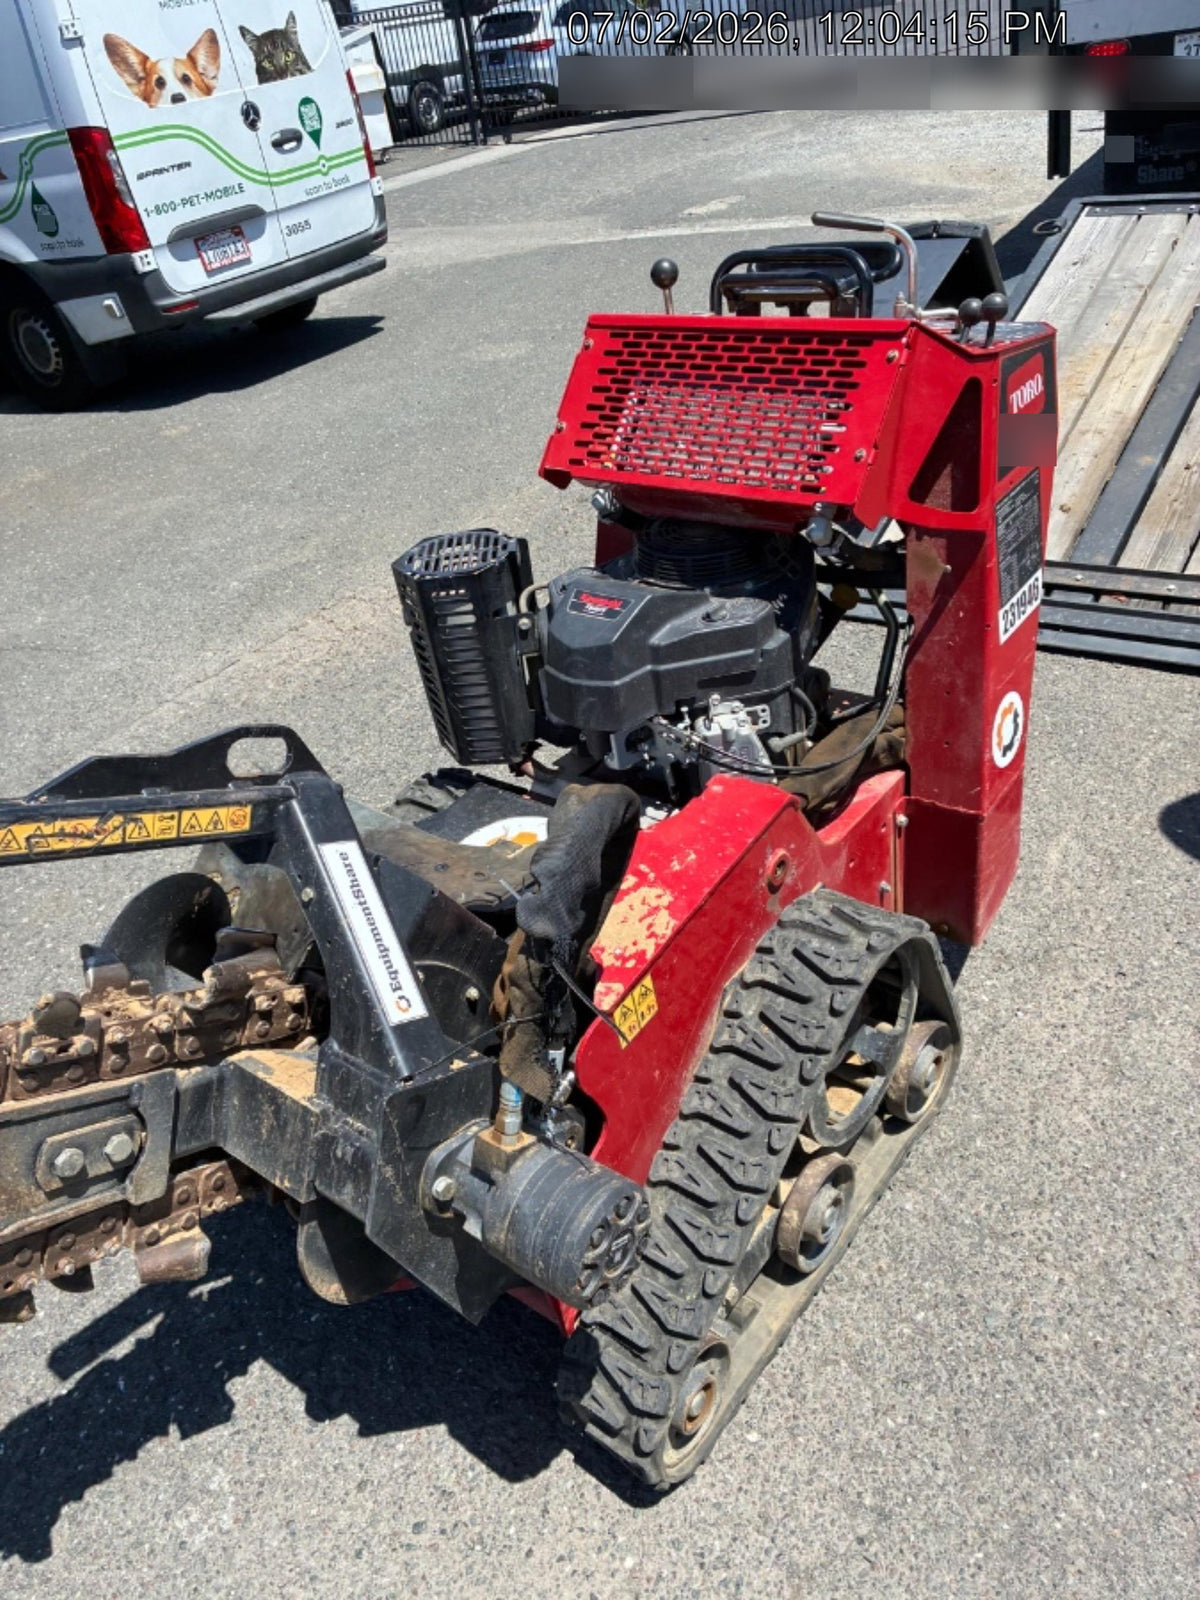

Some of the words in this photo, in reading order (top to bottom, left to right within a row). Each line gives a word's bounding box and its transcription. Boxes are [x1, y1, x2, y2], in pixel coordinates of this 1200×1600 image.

[136, 161, 192, 181] SPRINTER
[1137, 164, 1184, 184] Share
[304, 184, 324, 197] scan
[323, 181, 333, 191] to
[332, 174, 351, 187] book
[143, 183, 246, 218] 1-800-PET-MOBILE
[285, 219, 312, 237] 3055
[1009, 373, 1043, 414] TORO
[338, 850, 404, 994] EquipmentShare
